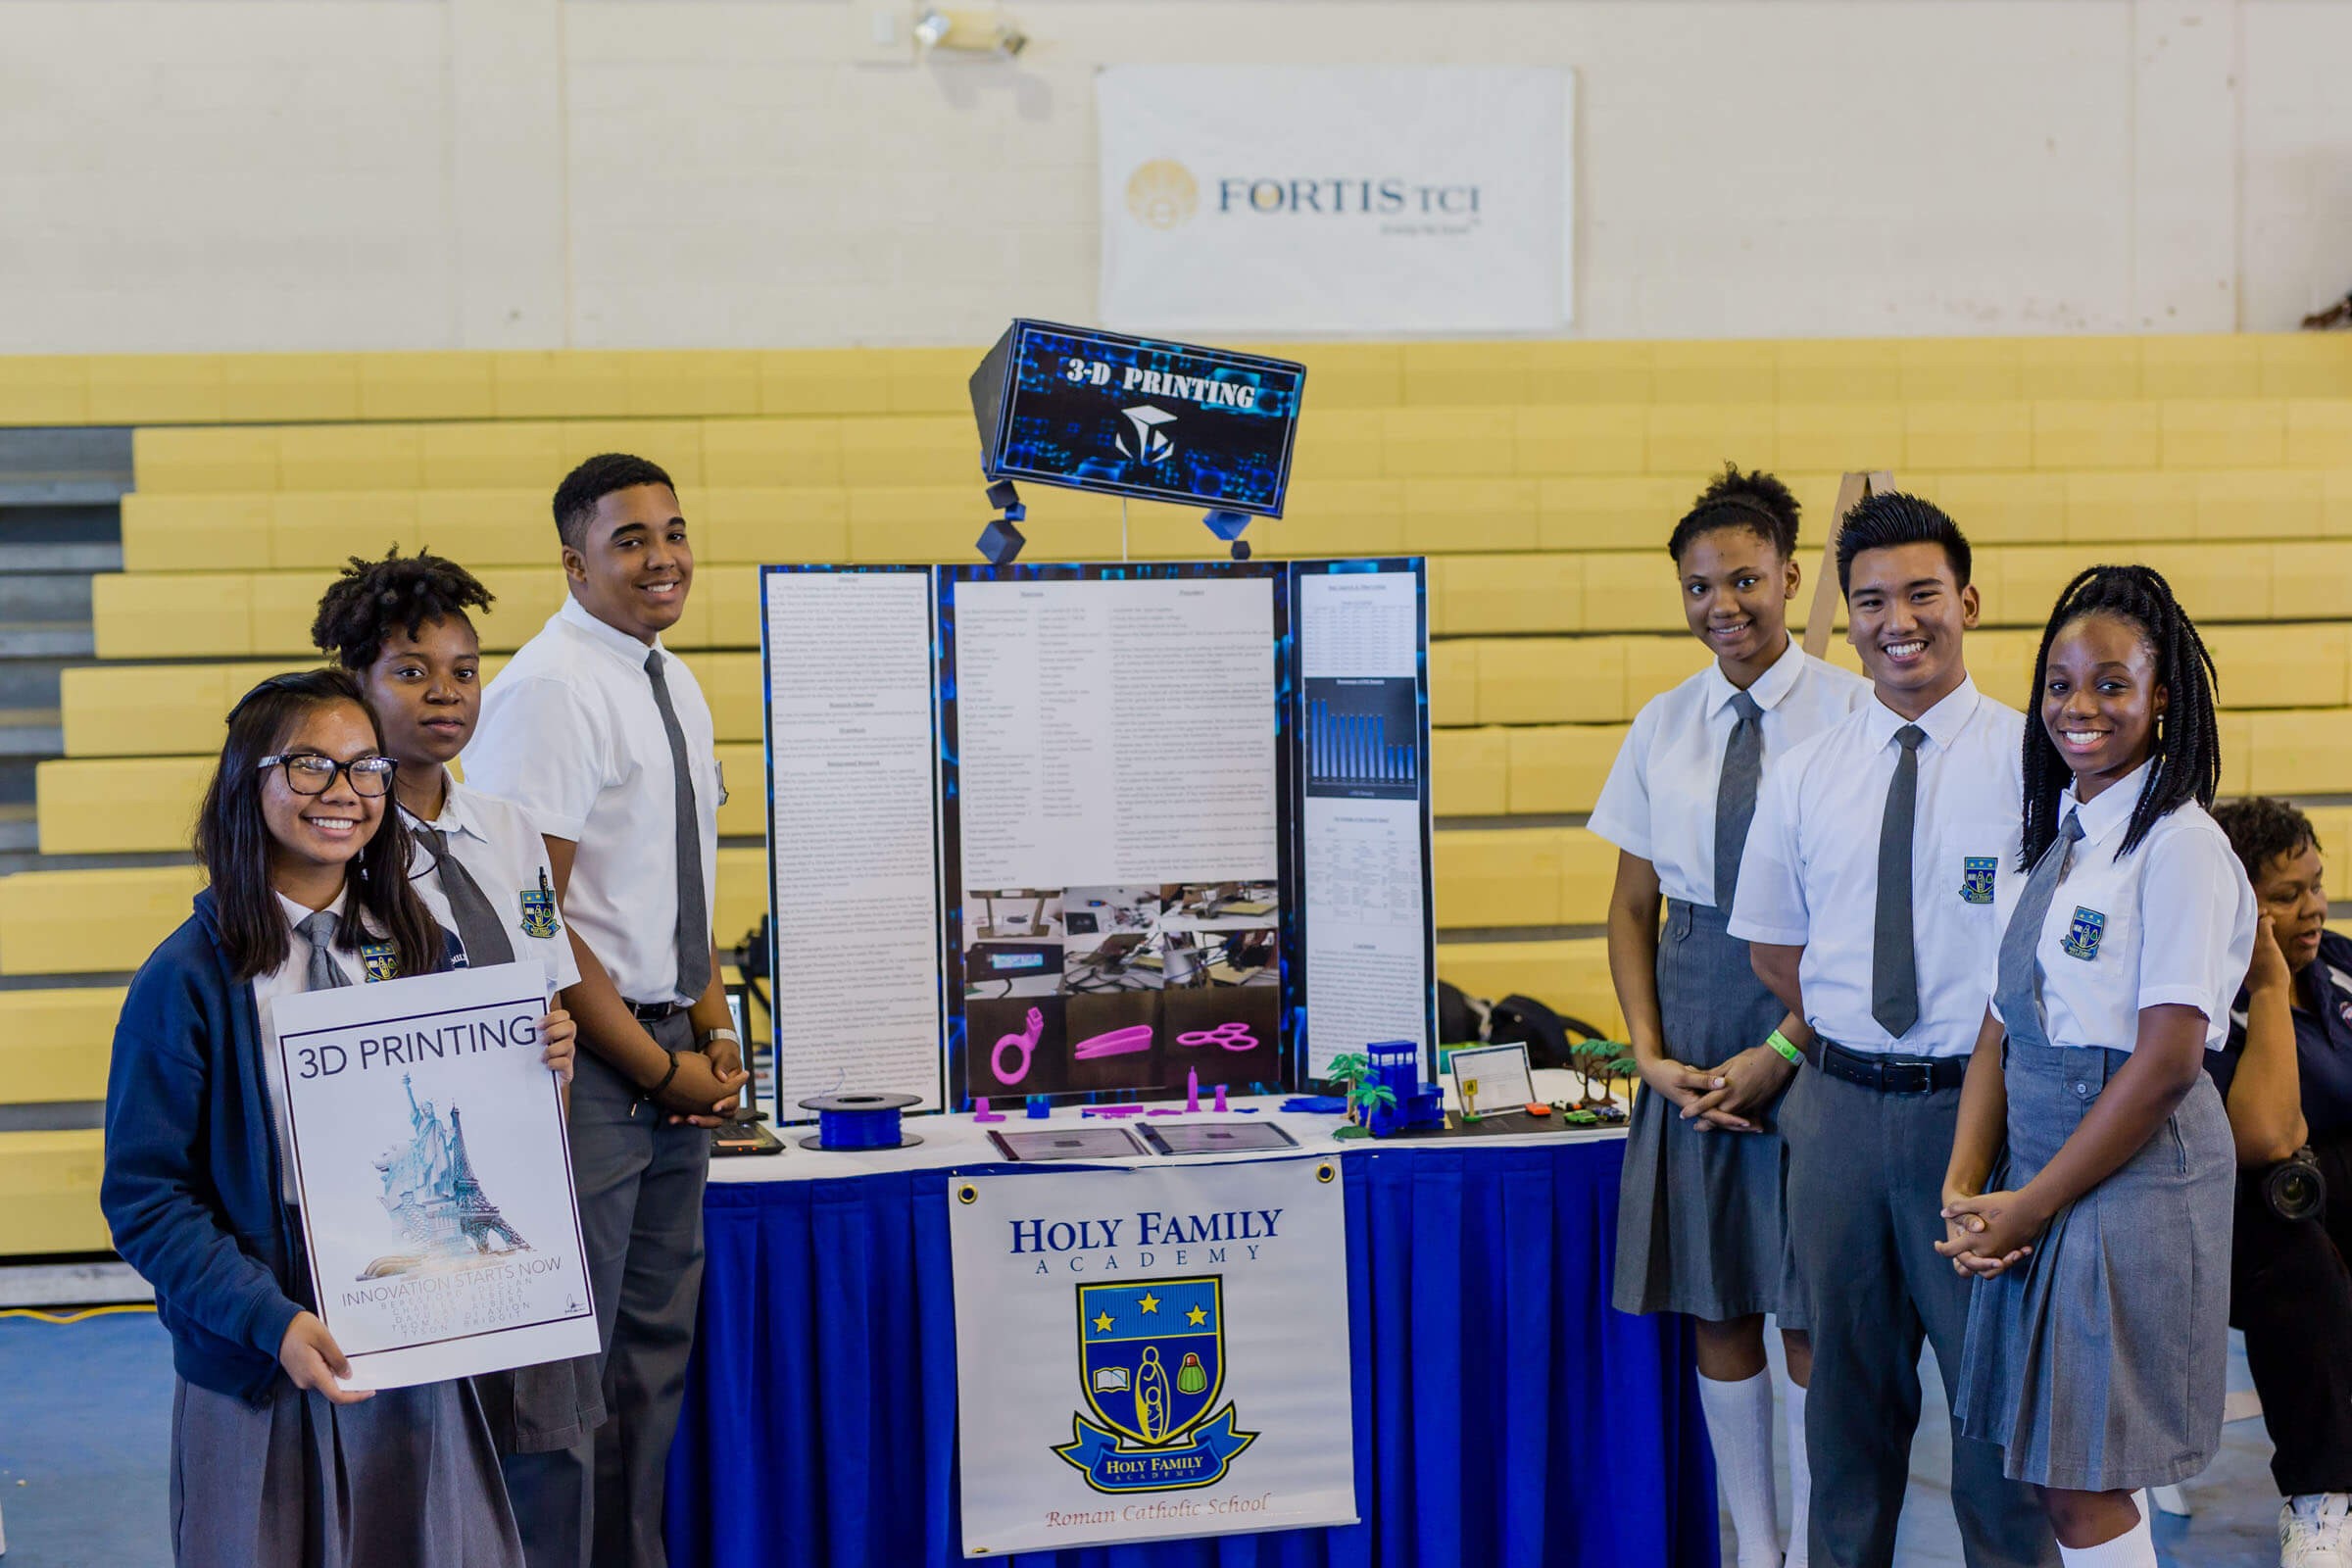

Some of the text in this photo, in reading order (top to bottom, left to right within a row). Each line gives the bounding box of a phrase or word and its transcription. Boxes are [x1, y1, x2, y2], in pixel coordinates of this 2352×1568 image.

[1217, 177, 1481, 215] FORTIS TCI
[1066, 358, 1255, 410] 3-D PRINTING
[297, 1014, 537, 1079] 3D PRINTING
[1008, 1208, 1283, 1254] HOLY FAMILY
[1035, 1245, 1259, 1274] ACADEMY
[341, 1256, 562, 1306] INNOVATION STARTS NOW
[1106, 1456, 1203, 1474] HOLY FAMILY
[1046, 1493, 1271, 1528] Roman Catholic School
